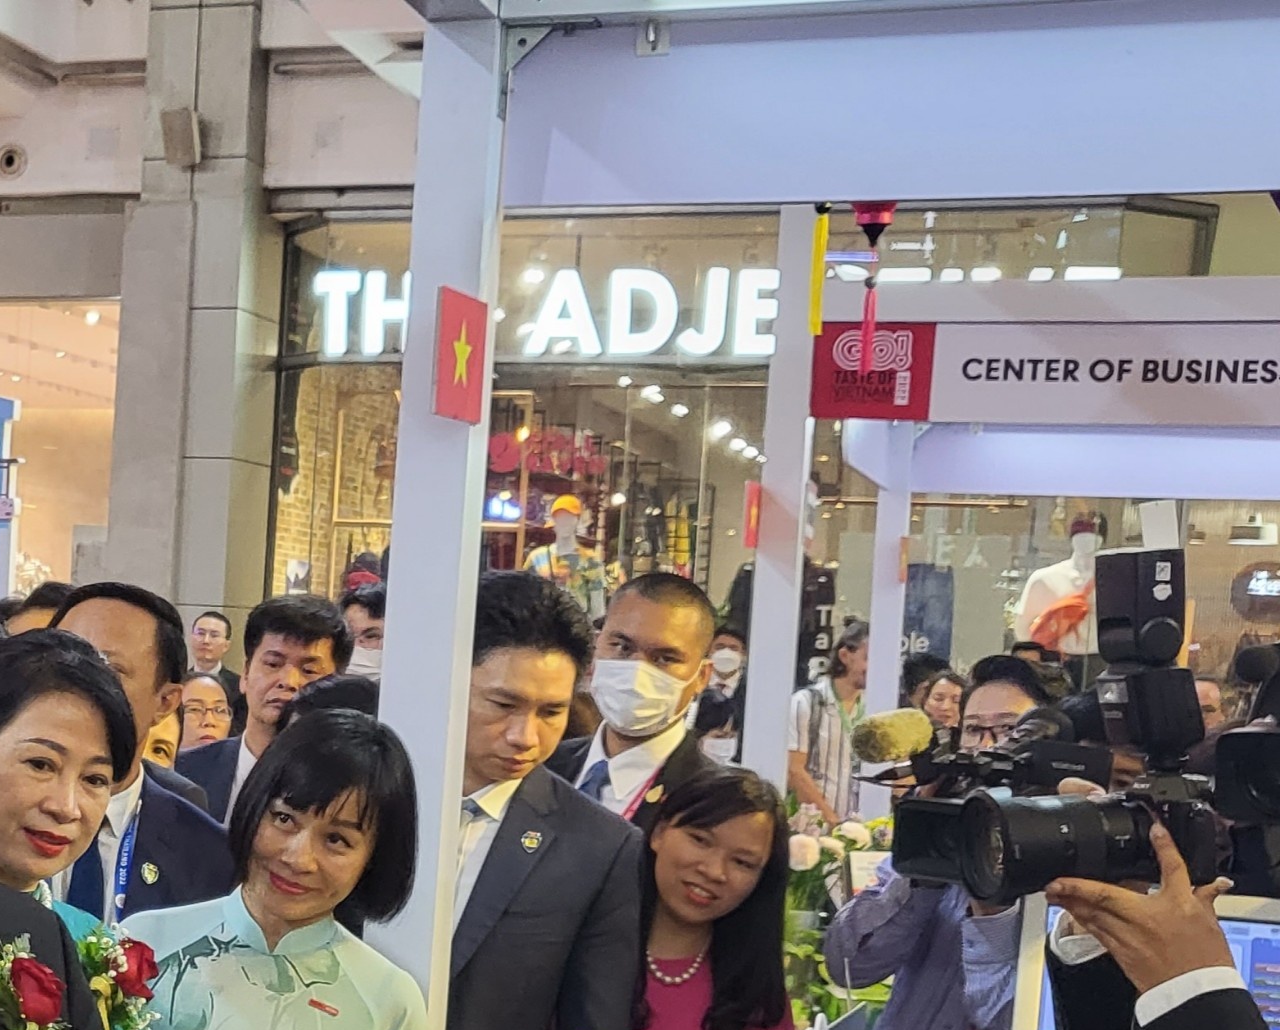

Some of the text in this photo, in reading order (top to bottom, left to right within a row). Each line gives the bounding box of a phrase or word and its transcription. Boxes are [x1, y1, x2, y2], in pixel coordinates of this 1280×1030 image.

[877, 370, 897, 386] OF
[961, 357, 1280, 384] CENTER OF BUSINES
